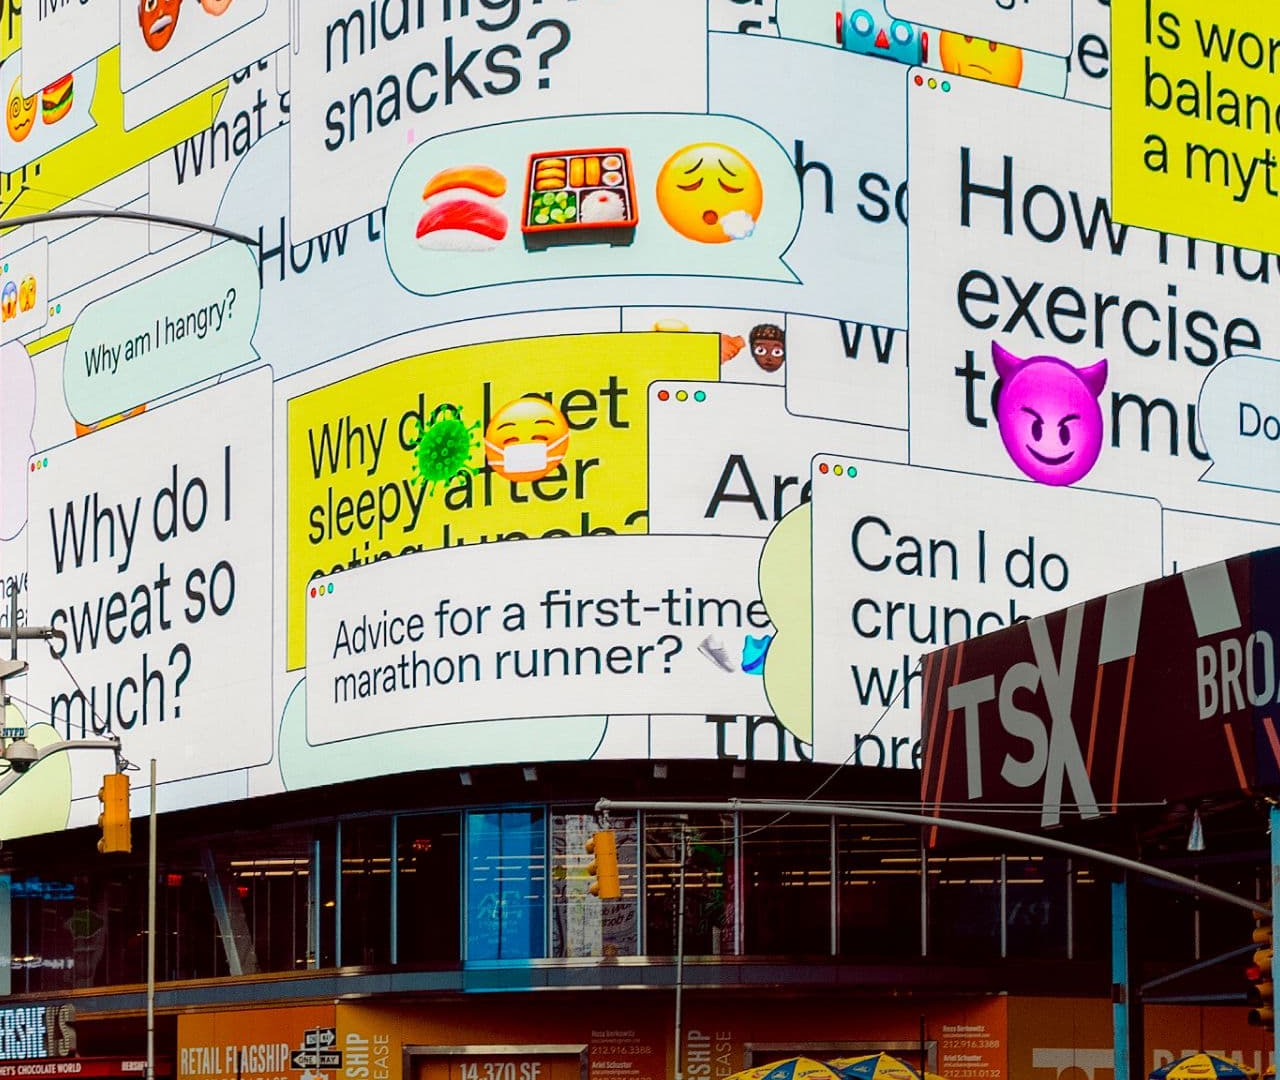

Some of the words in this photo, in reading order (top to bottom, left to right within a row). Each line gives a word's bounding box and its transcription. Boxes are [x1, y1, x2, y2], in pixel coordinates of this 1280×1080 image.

[324, 18, 572, 152] snacks?
[959, 147, 1126, 255] How
[83, 341, 122, 380] Why
[123, 334, 151, 363] am
[164, 288, 237, 346] hangry?
[957, 268, 1262, 367] exercise
[308, 414, 388, 480] Why
[1239, 403, 1280, 440] Do
[48, 490, 143, 578] Why
[153, 462, 208, 543] do
[308, 476, 429, 546] sleepy
[851, 516, 958, 581] Can
[1005, 536, 1069, 592] do
[50, 560, 173, 661] sweat
[184, 559, 236, 625] so
[333, 610, 425, 660] Advice
[433, 596, 492, 638] for
[539, 586, 772, 631] first-time
[50, 641, 192, 744] much?
[333, 643, 481, 706] marathon
[494, 633, 684, 681] runner?
[2, 728, 25, 737] NYPD
[948, 600, 1101, 828] TSX
[17, 1064, 57, 1075] CHOCOLATE
[57, 1062, 82, 1073] WORLD
[180, 1047, 222, 1075] RETAIL
[226, 1043, 289, 1075] FLAGSHIP
[520, 1062, 541, 1080] SF
